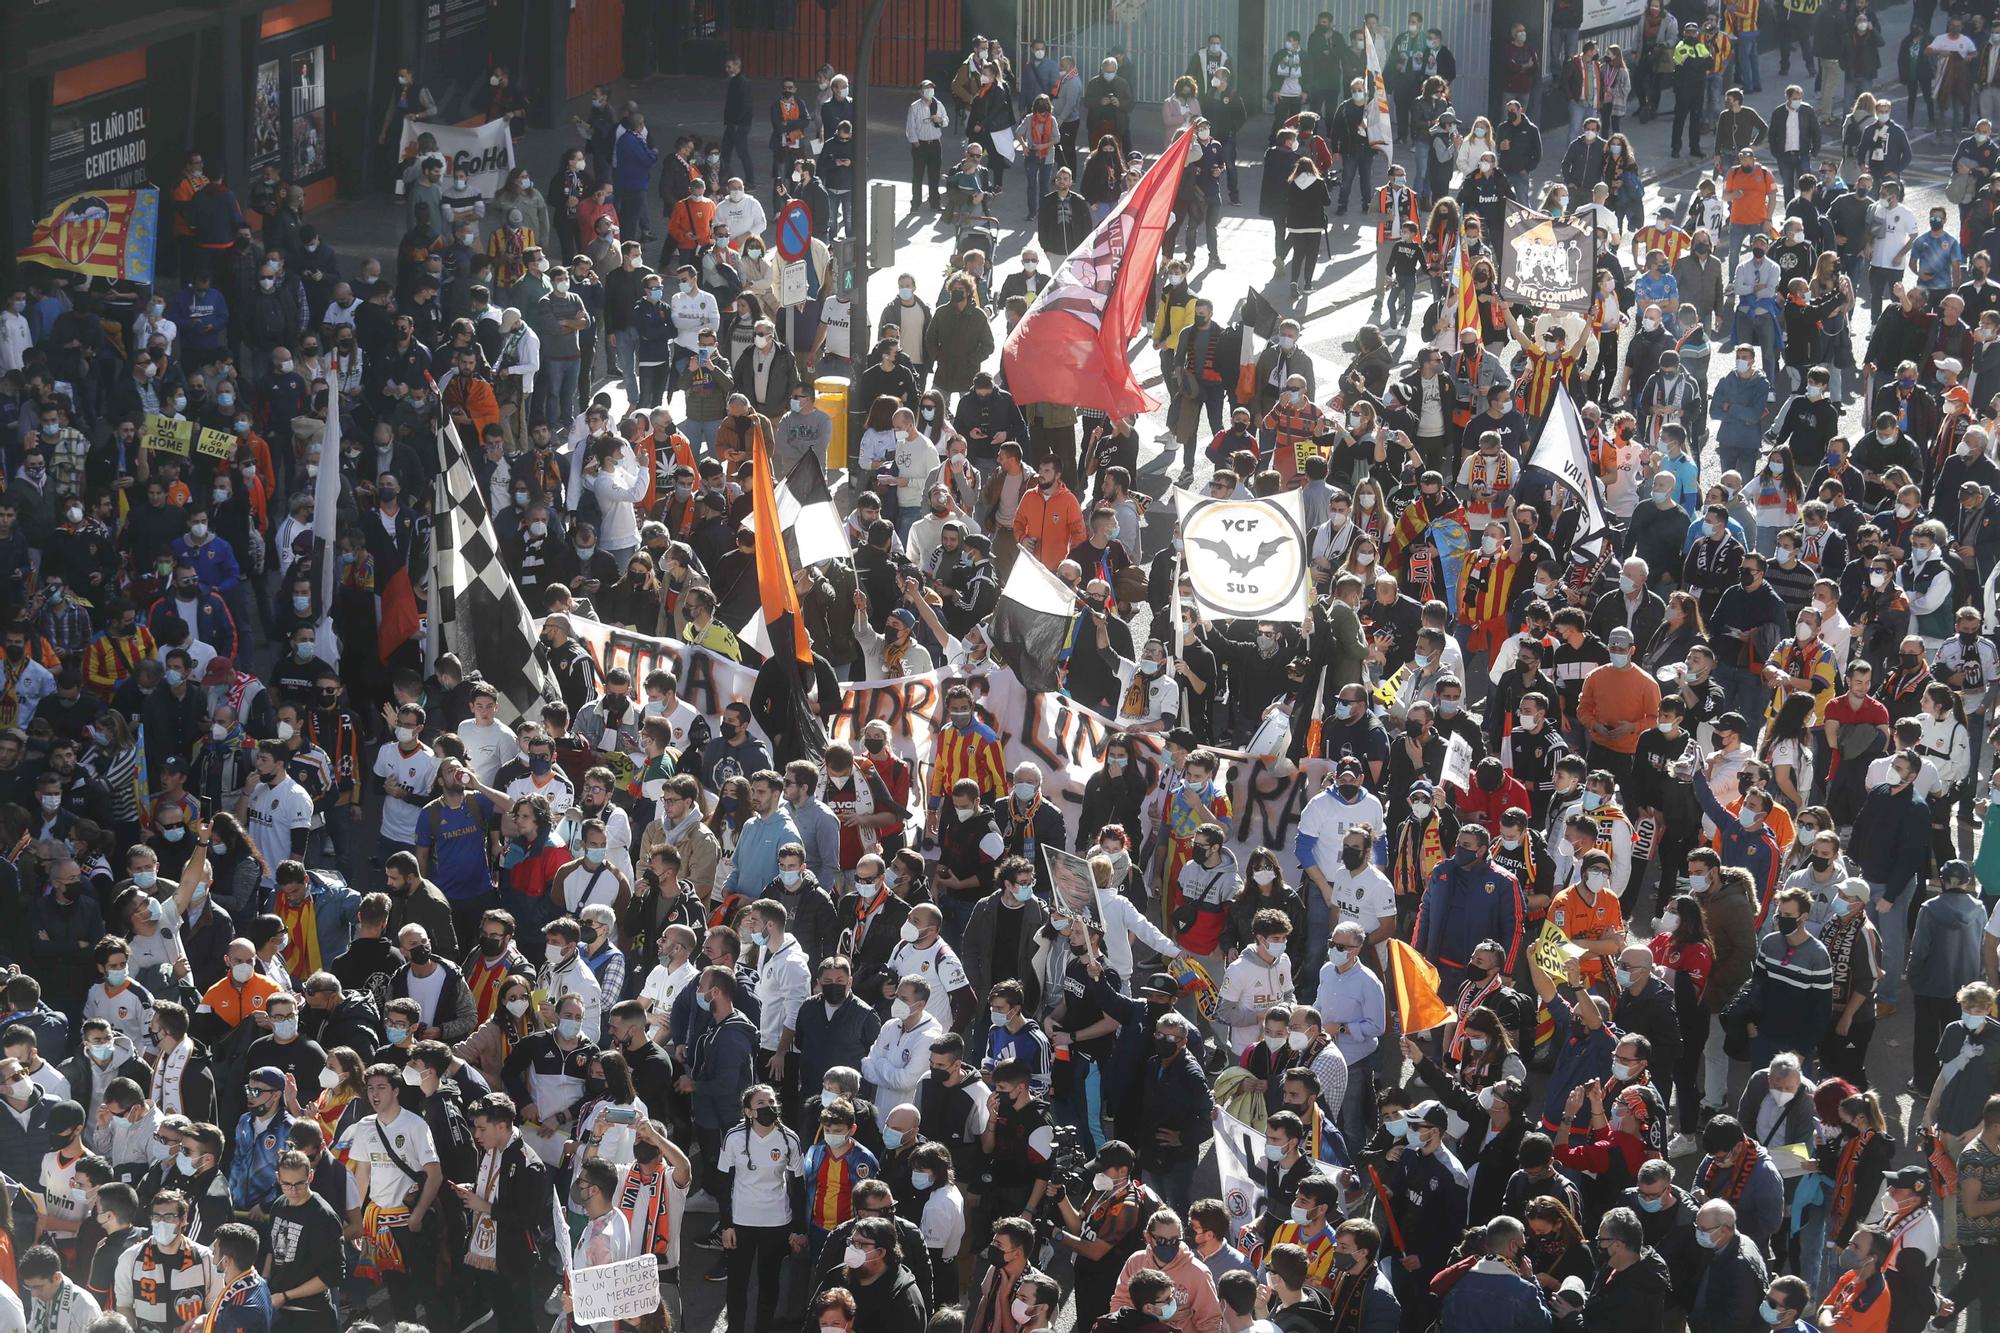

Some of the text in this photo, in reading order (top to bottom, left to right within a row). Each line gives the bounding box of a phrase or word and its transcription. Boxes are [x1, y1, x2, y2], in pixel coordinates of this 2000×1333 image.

[91, 123, 102, 146] EL
[105, 112, 125, 140] AÑO
[127, 107, 146, 135] DEL
[85, 139, 147, 180] CENTENARIO
[1540, 287, 1588, 302] CONTINUA
[827, 317, 849, 328] bwin
[156, 420, 179, 432] LIM
[159, 431, 176, 440] GO
[207, 430, 230, 444] LIM
[148, 437, 183, 453] HOME
[199, 444, 230, 459] HOME
[210, 440, 223, 449] GO
[1296, 444, 1305, 471] HOME
[1221, 519, 1259, 533] VCF
[1226, 582, 1260, 595] SUD
[1631, 820, 1655, 861] NORD
[1541, 942, 1558, 958] GO
[1835, 917, 1862, 984] CAMPEÓN
[1535, 953, 1568, 977] HOME
[48, 1189, 75, 1211] bwin
[575, 1257, 657, 1283] EL VCF MERECE
[593, 1269, 656, 1291] UN FUTURO
[578, 1278, 659, 1308] YO MEREZCO
[578, 1306, 607, 1321] VIVIR
[613, 1302, 633, 1317] ESE
